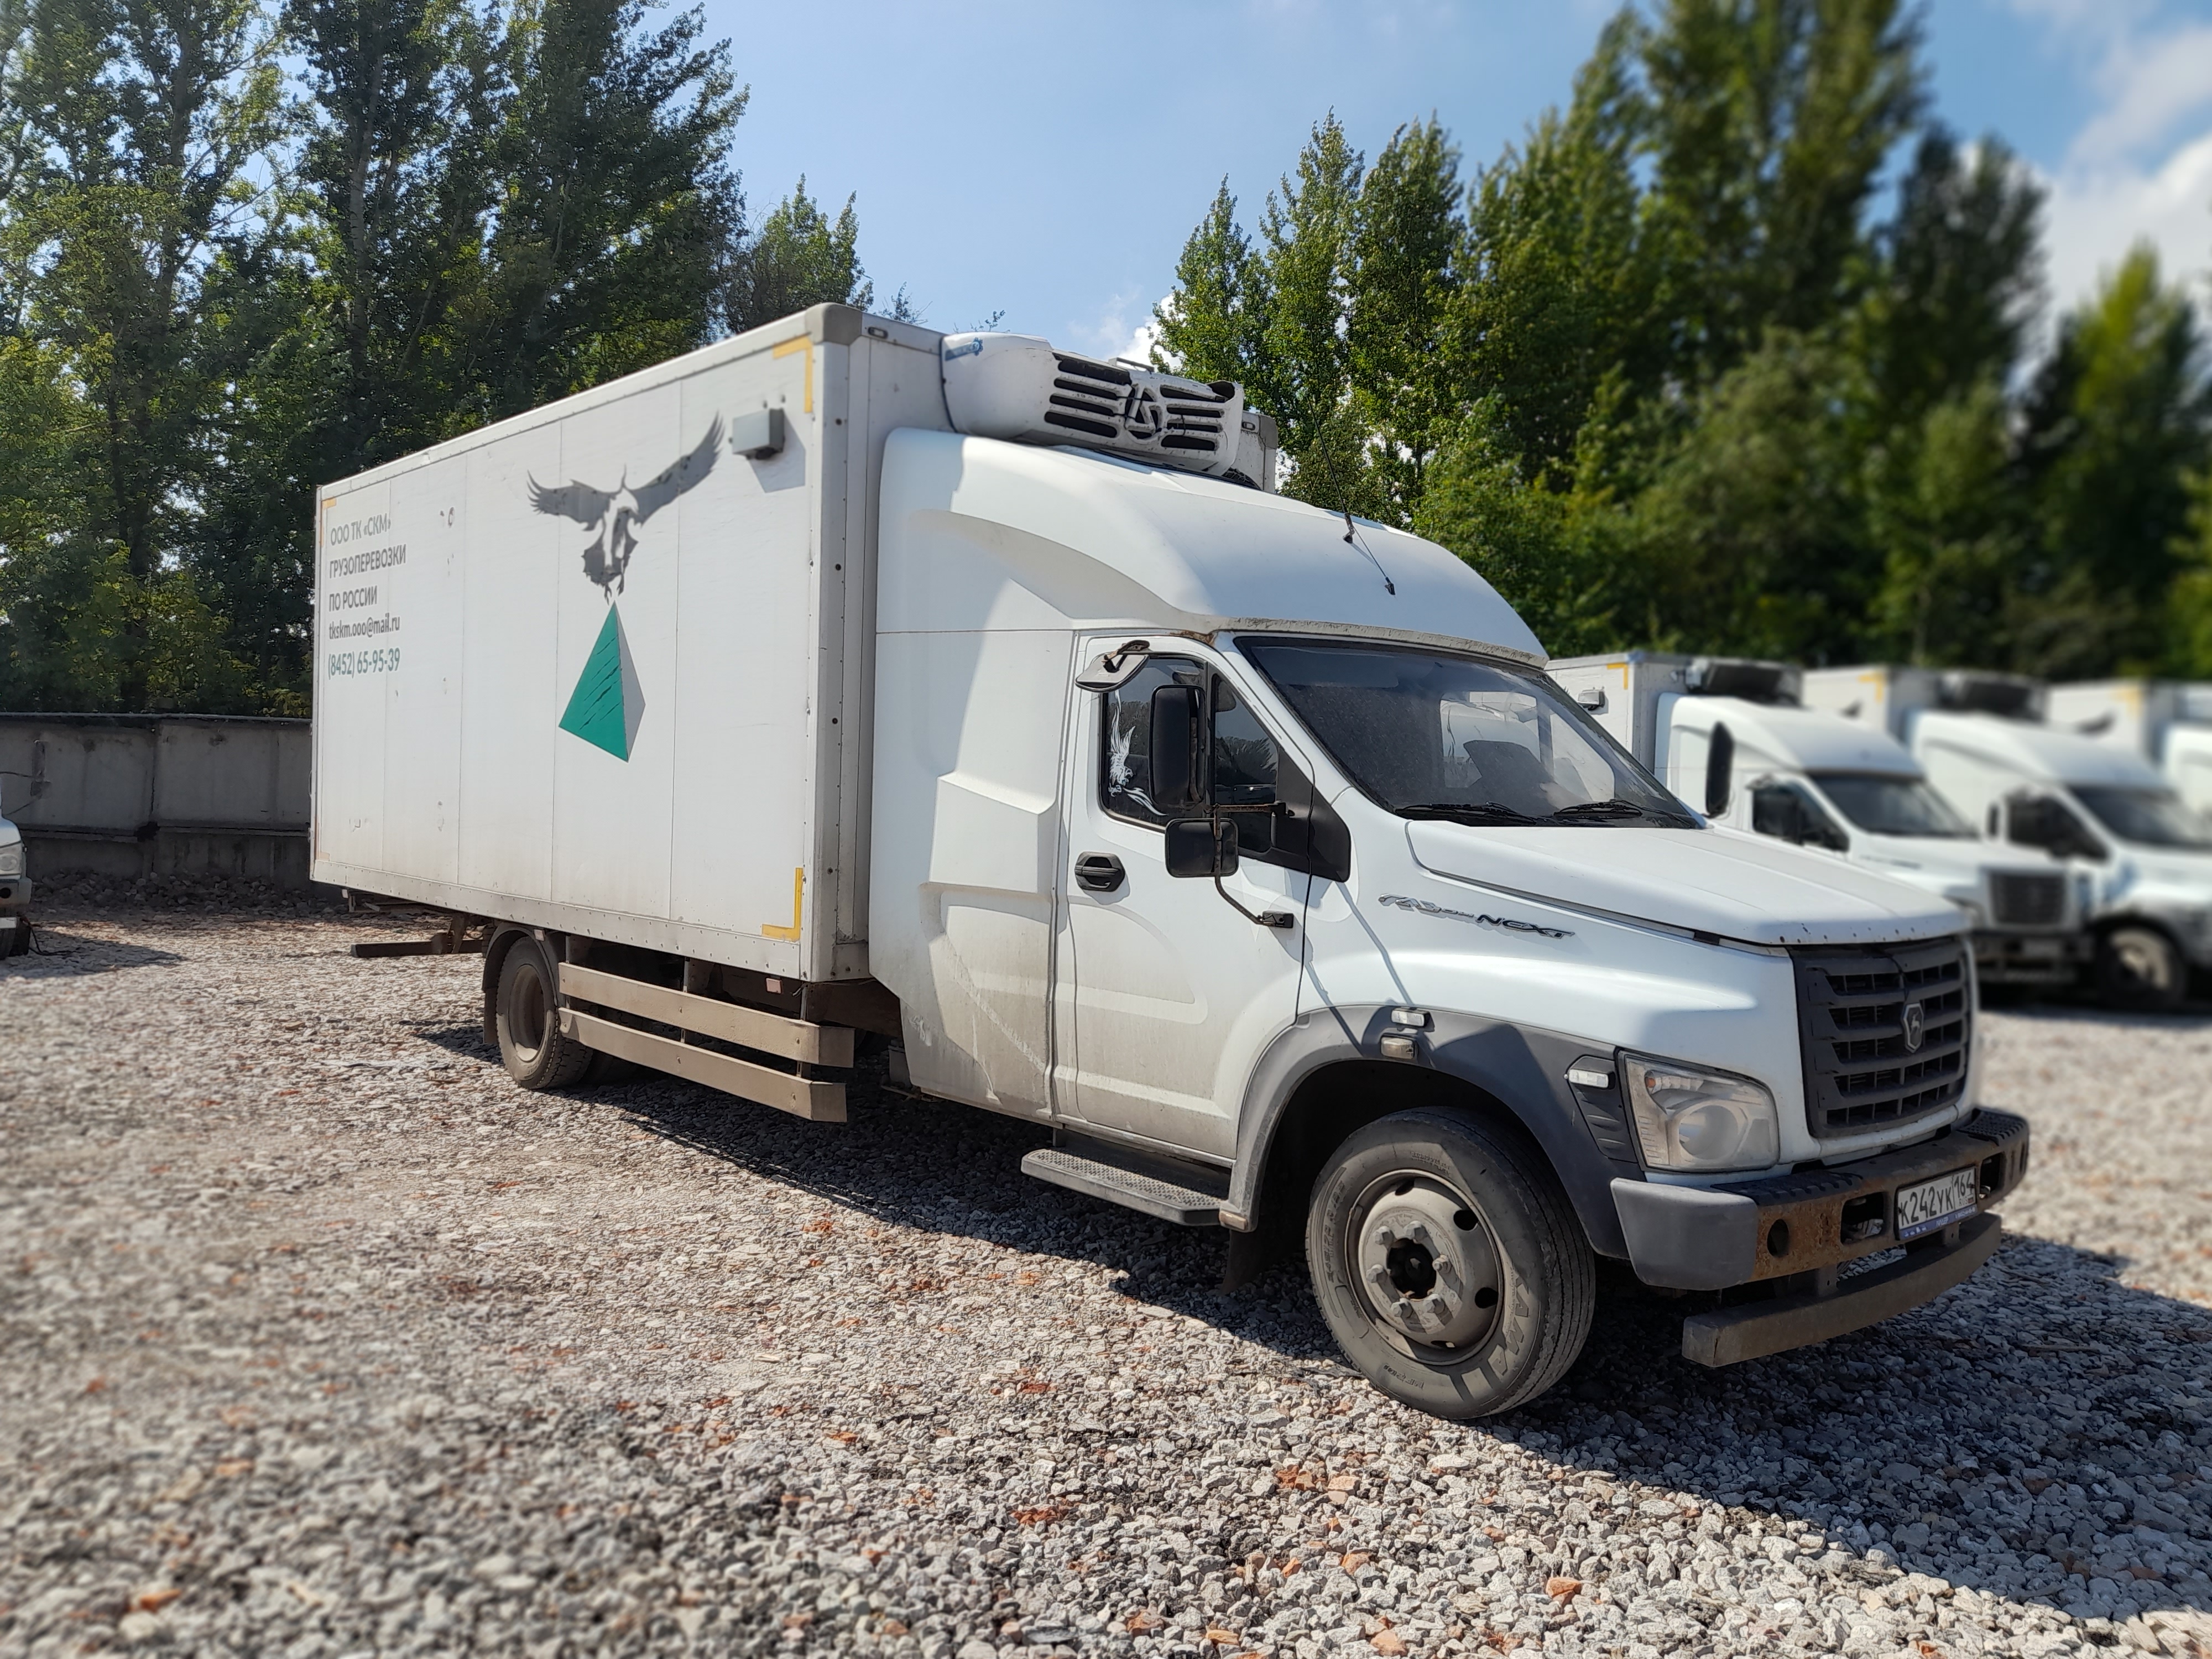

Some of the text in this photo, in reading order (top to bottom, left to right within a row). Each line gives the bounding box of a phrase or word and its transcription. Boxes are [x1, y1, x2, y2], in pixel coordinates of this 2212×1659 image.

[331, 513, 391, 546] ООО ТК «СКМ»
[330, 544, 406, 578] ГРУЗОПЕРЕВОЗКИ
[329, 585, 377, 612] ПО РОССИИ
[329, 612, 400, 639] tkskm.ooo@mail.ru
[328, 648, 400, 680] (8452) 65-95-39
